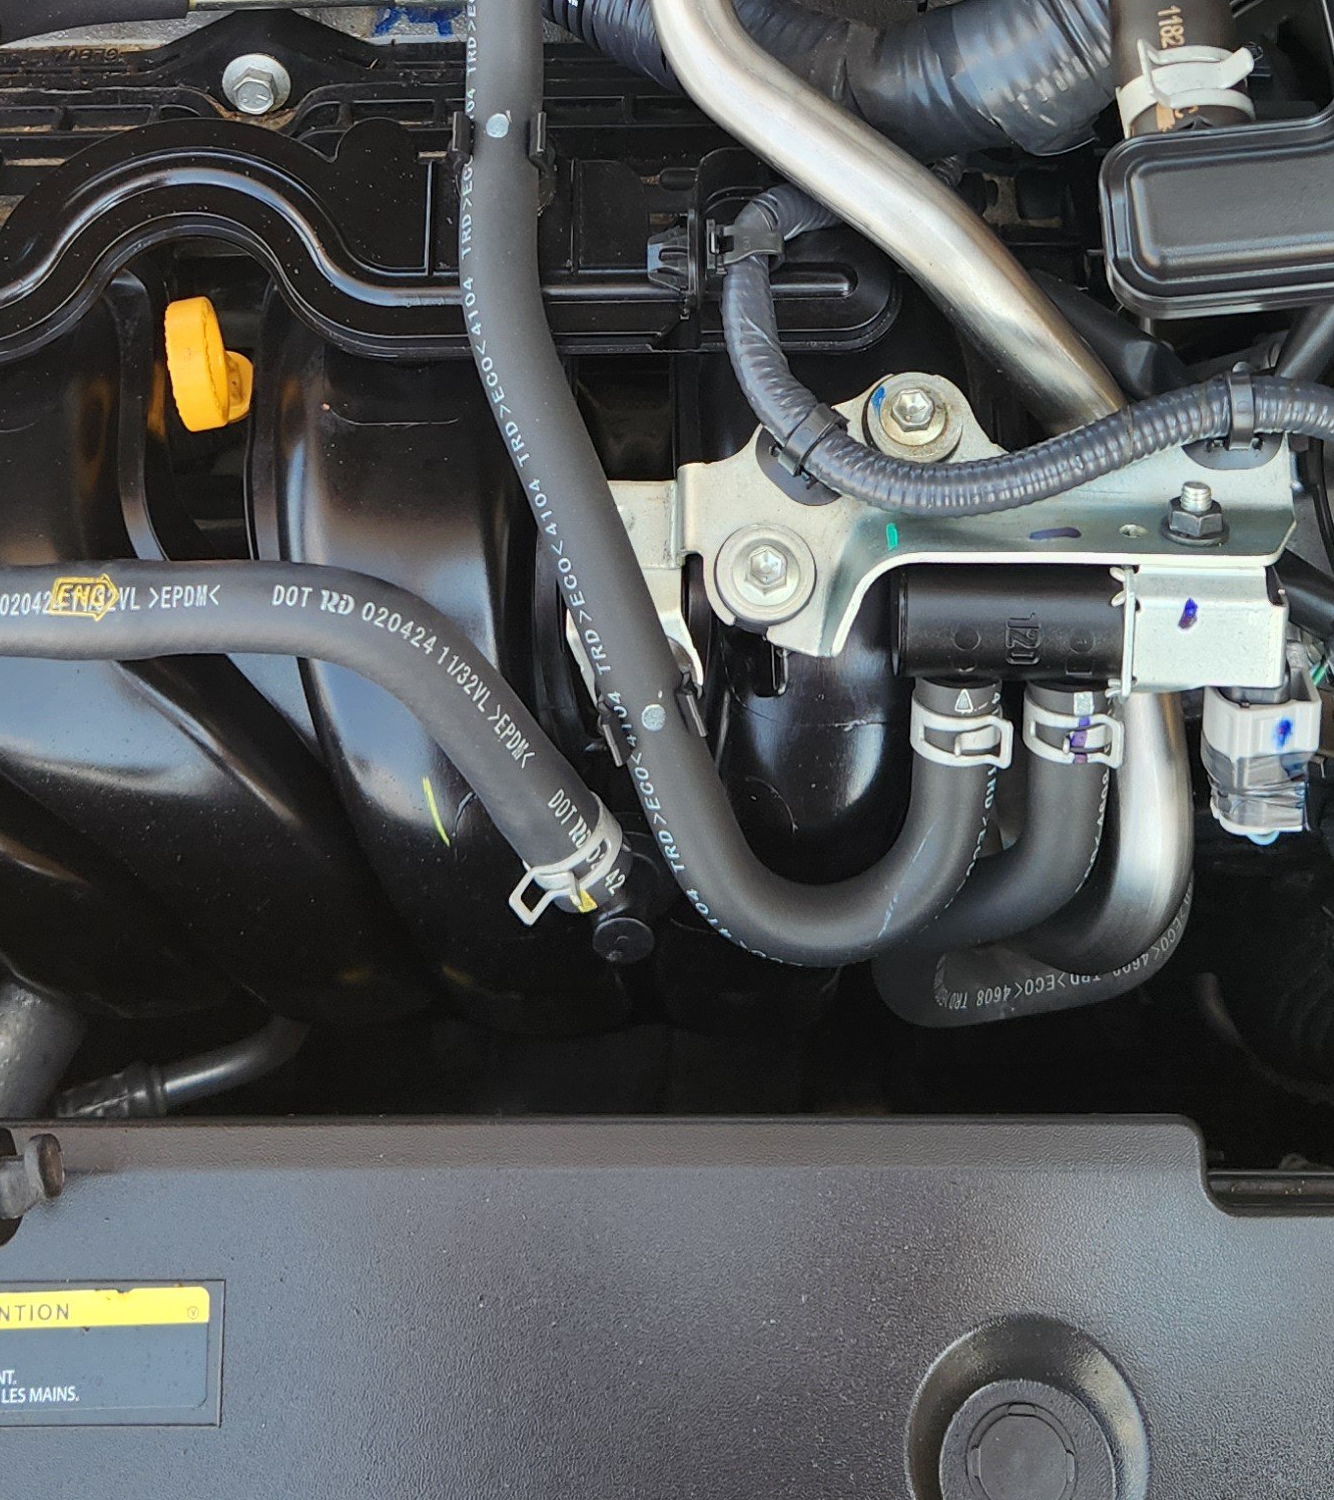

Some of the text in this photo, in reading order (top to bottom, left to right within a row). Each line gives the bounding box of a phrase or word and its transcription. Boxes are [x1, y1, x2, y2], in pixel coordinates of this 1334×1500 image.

[271, 584, 313, 608] DOT
[362, 601, 438, 655] 020424
[547, 788, 577, 826] DOT
[1, 1387, 26, 1404] LES
[29, 1385, 80, 1403] MAINS.
